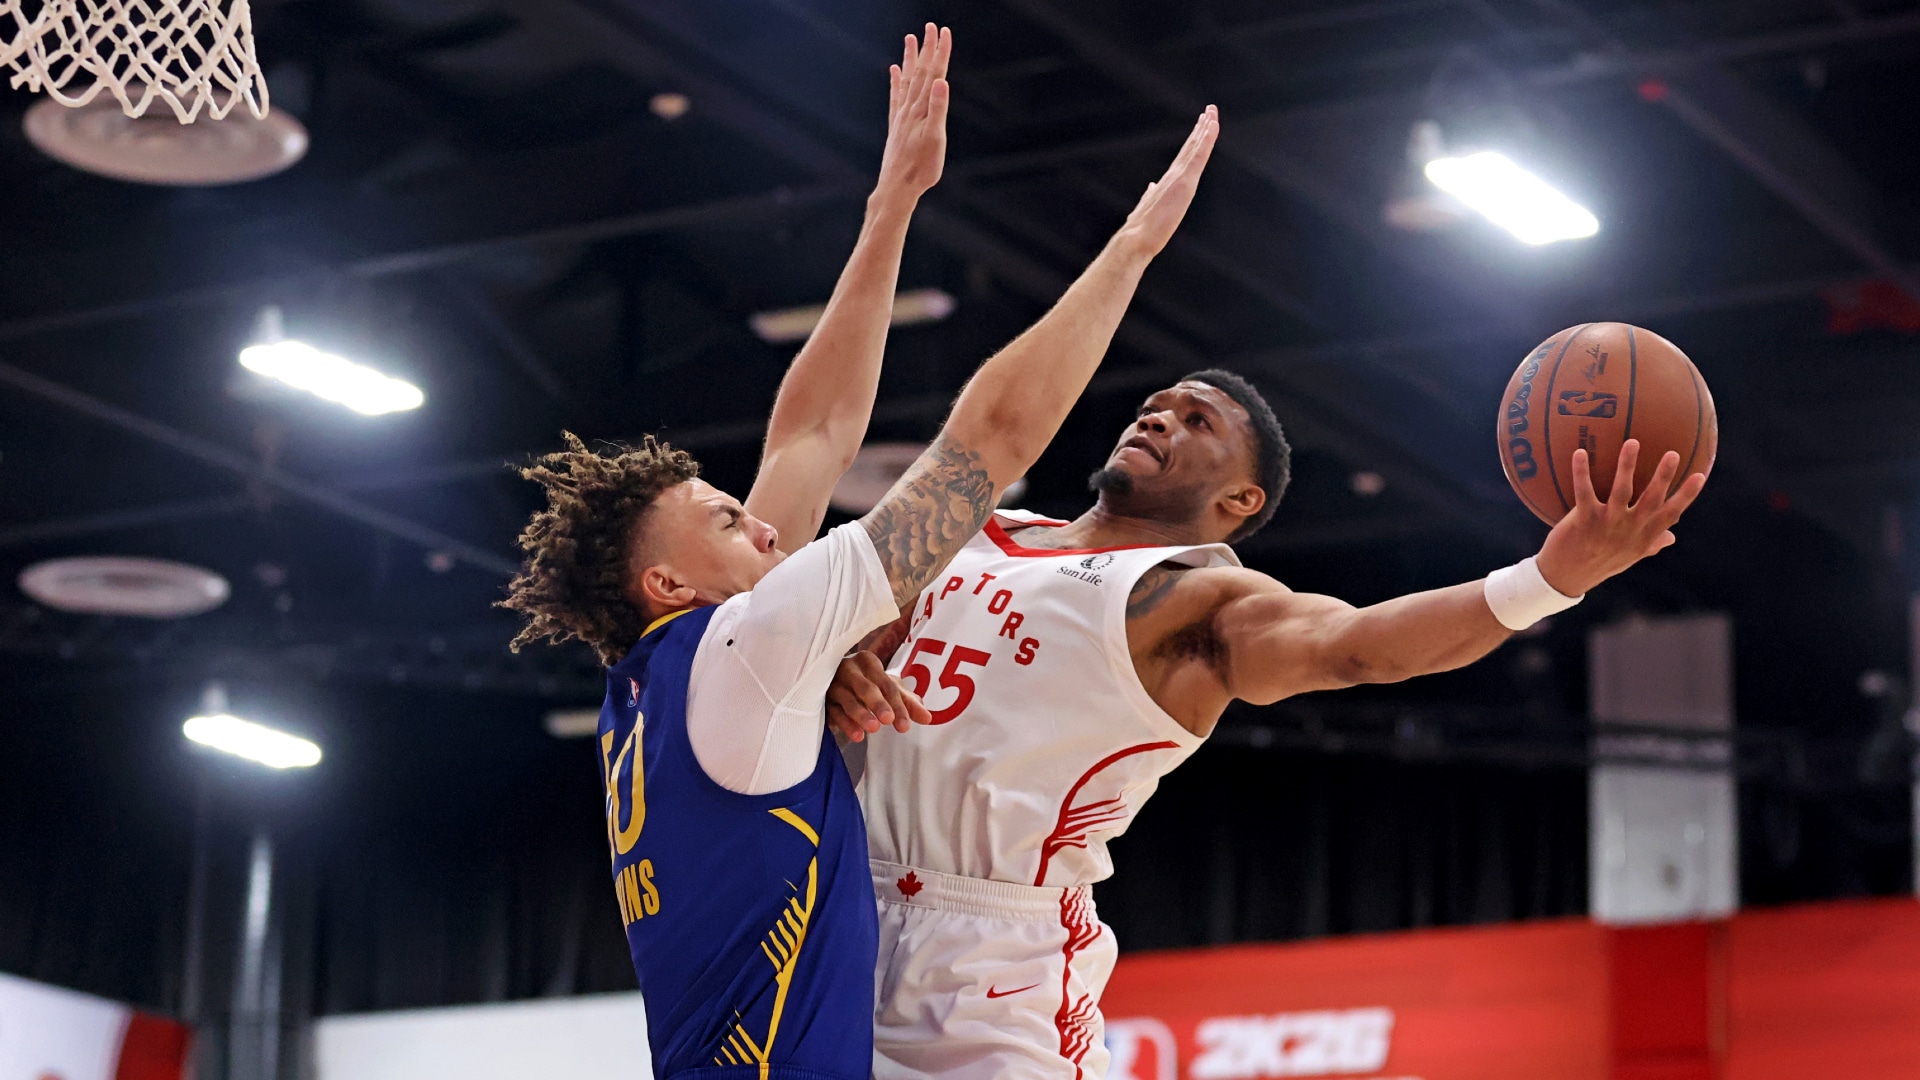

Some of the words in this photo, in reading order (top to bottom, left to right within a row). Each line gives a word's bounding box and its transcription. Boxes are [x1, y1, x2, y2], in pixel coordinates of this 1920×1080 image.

[904, 572, 1040, 665] APTORS
[1056, 566, 1080, 578] Sun
[1079, 571, 1102, 587] Life
[901, 637, 991, 725] 55
[601, 711, 646, 868] 50
